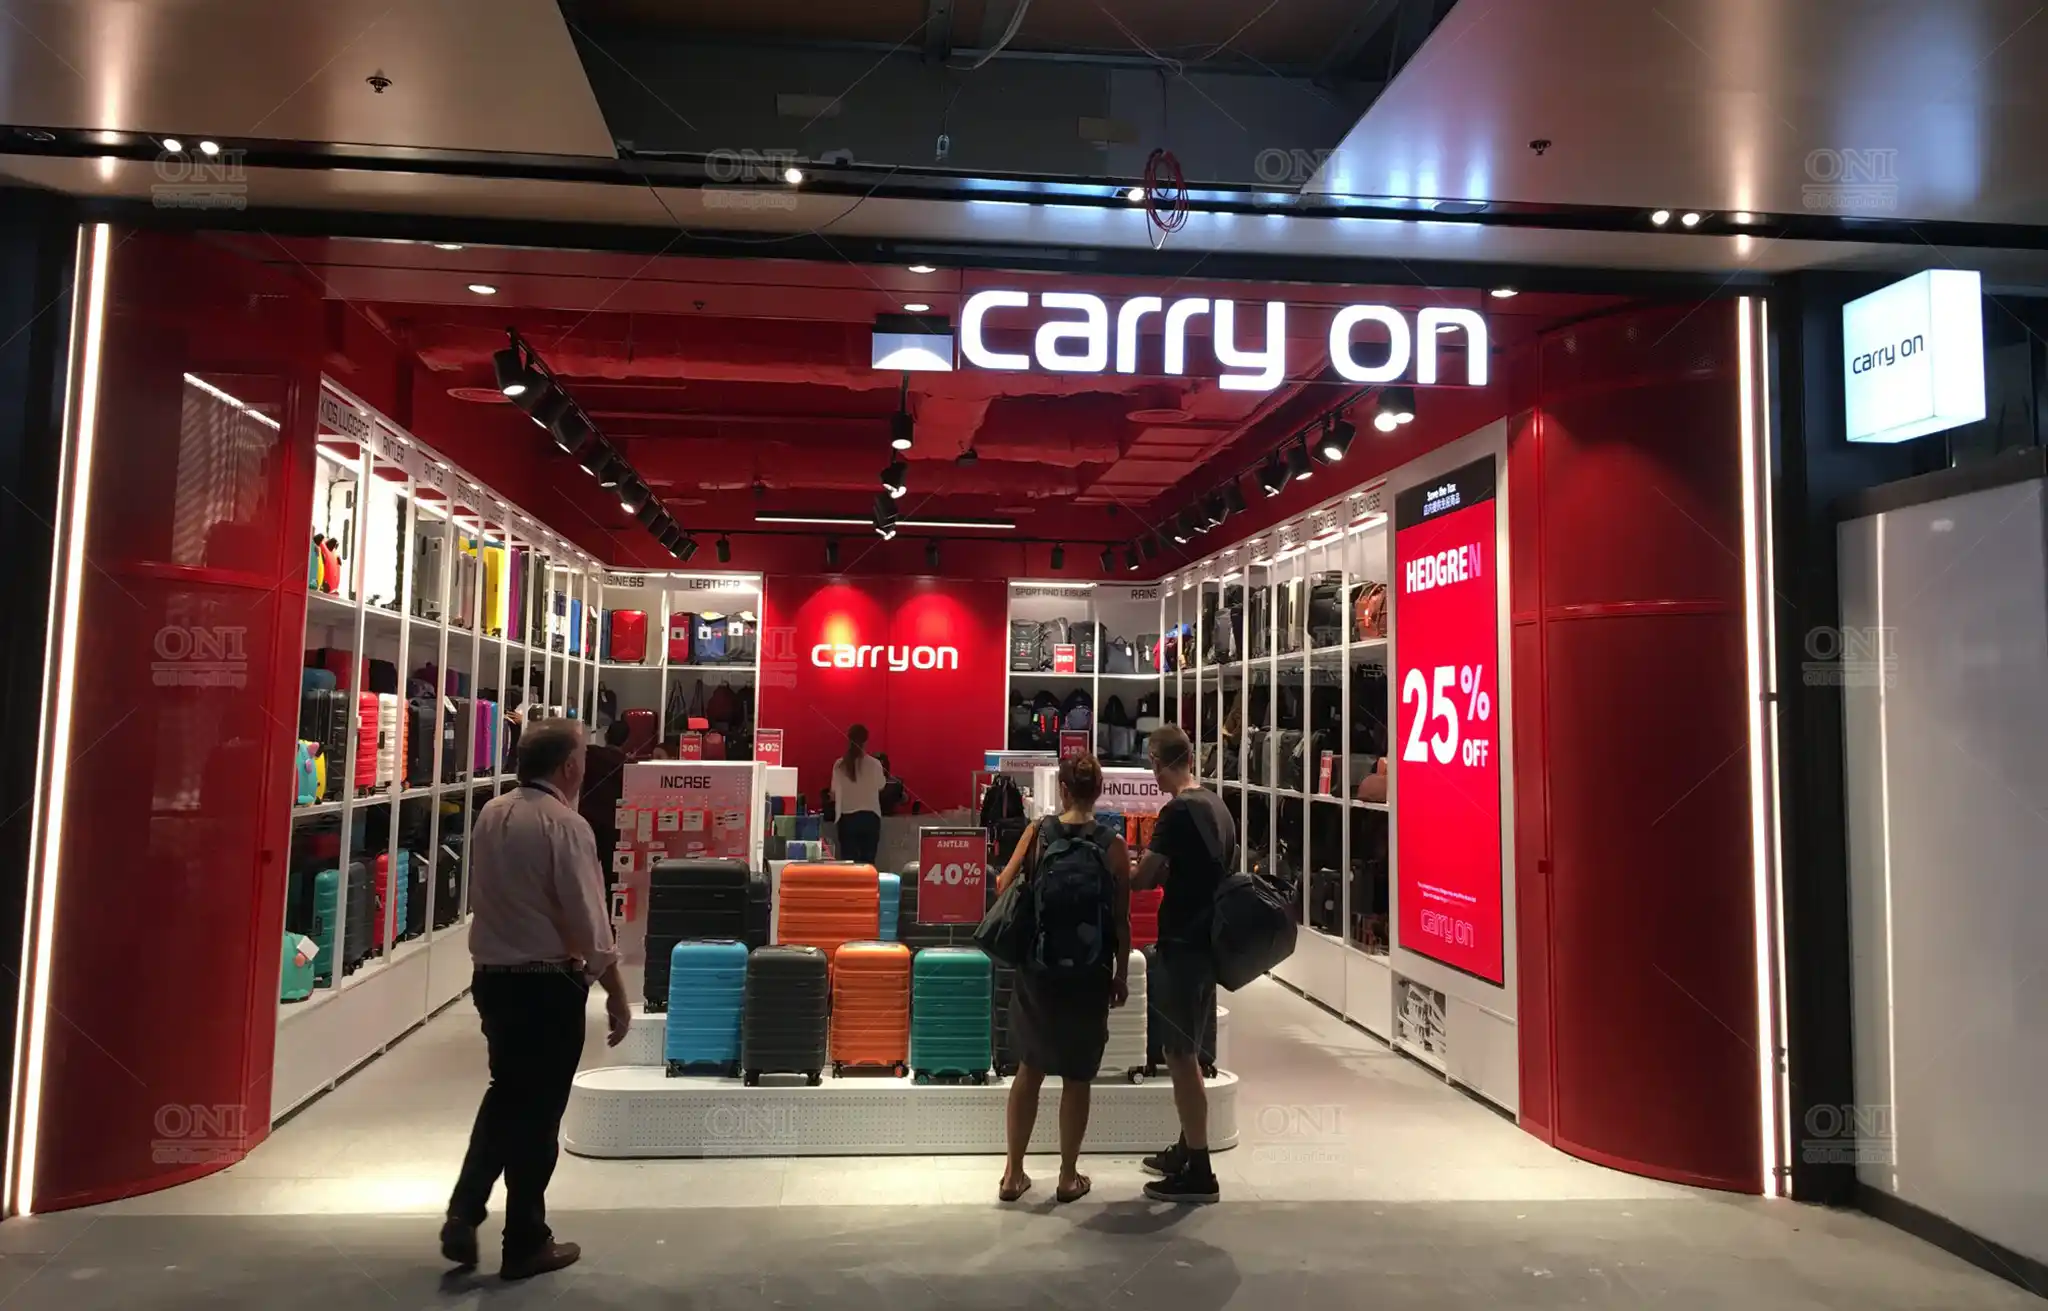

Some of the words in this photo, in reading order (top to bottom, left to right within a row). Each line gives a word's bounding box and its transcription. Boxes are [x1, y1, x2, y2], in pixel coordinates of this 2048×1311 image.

[961, 290, 1286, 391] carry
[1330, 304, 1488, 386] on
[1852, 344, 1896, 375] carry
[1900, 334, 1924, 358] on
[321, 395, 338, 423] KIDS
[338, 406, 371, 445] LUGGAGE
[383, 435, 405, 465] ANTLER
[1351, 492, 1381, 519] BUSINESS
[1312, 510, 1338, 535] BUSINESS
[1406, 541, 1481, 593] HEDGREN
[603, 575, 645, 588] USINESS
[689, 578, 741, 590] LEATHER
[1015, 587, 1041, 597] SPORT
[1042, 588, 1059, 597] AND
[1060, 588, 1092, 598] LEISURE
[1130, 587, 1157, 600] RAINS
[1402, 664, 1491, 765] 25%
[1462, 738, 1489, 768] OFF
[660, 775, 712, 790] INCASE
[936, 840, 970, 849] ANTLER
[923, 862, 982, 886] 40%
[963, 876, 981, 886] OFF
[1420, 908, 1455, 944] carry
[1455, 919, 1475, 949] on
